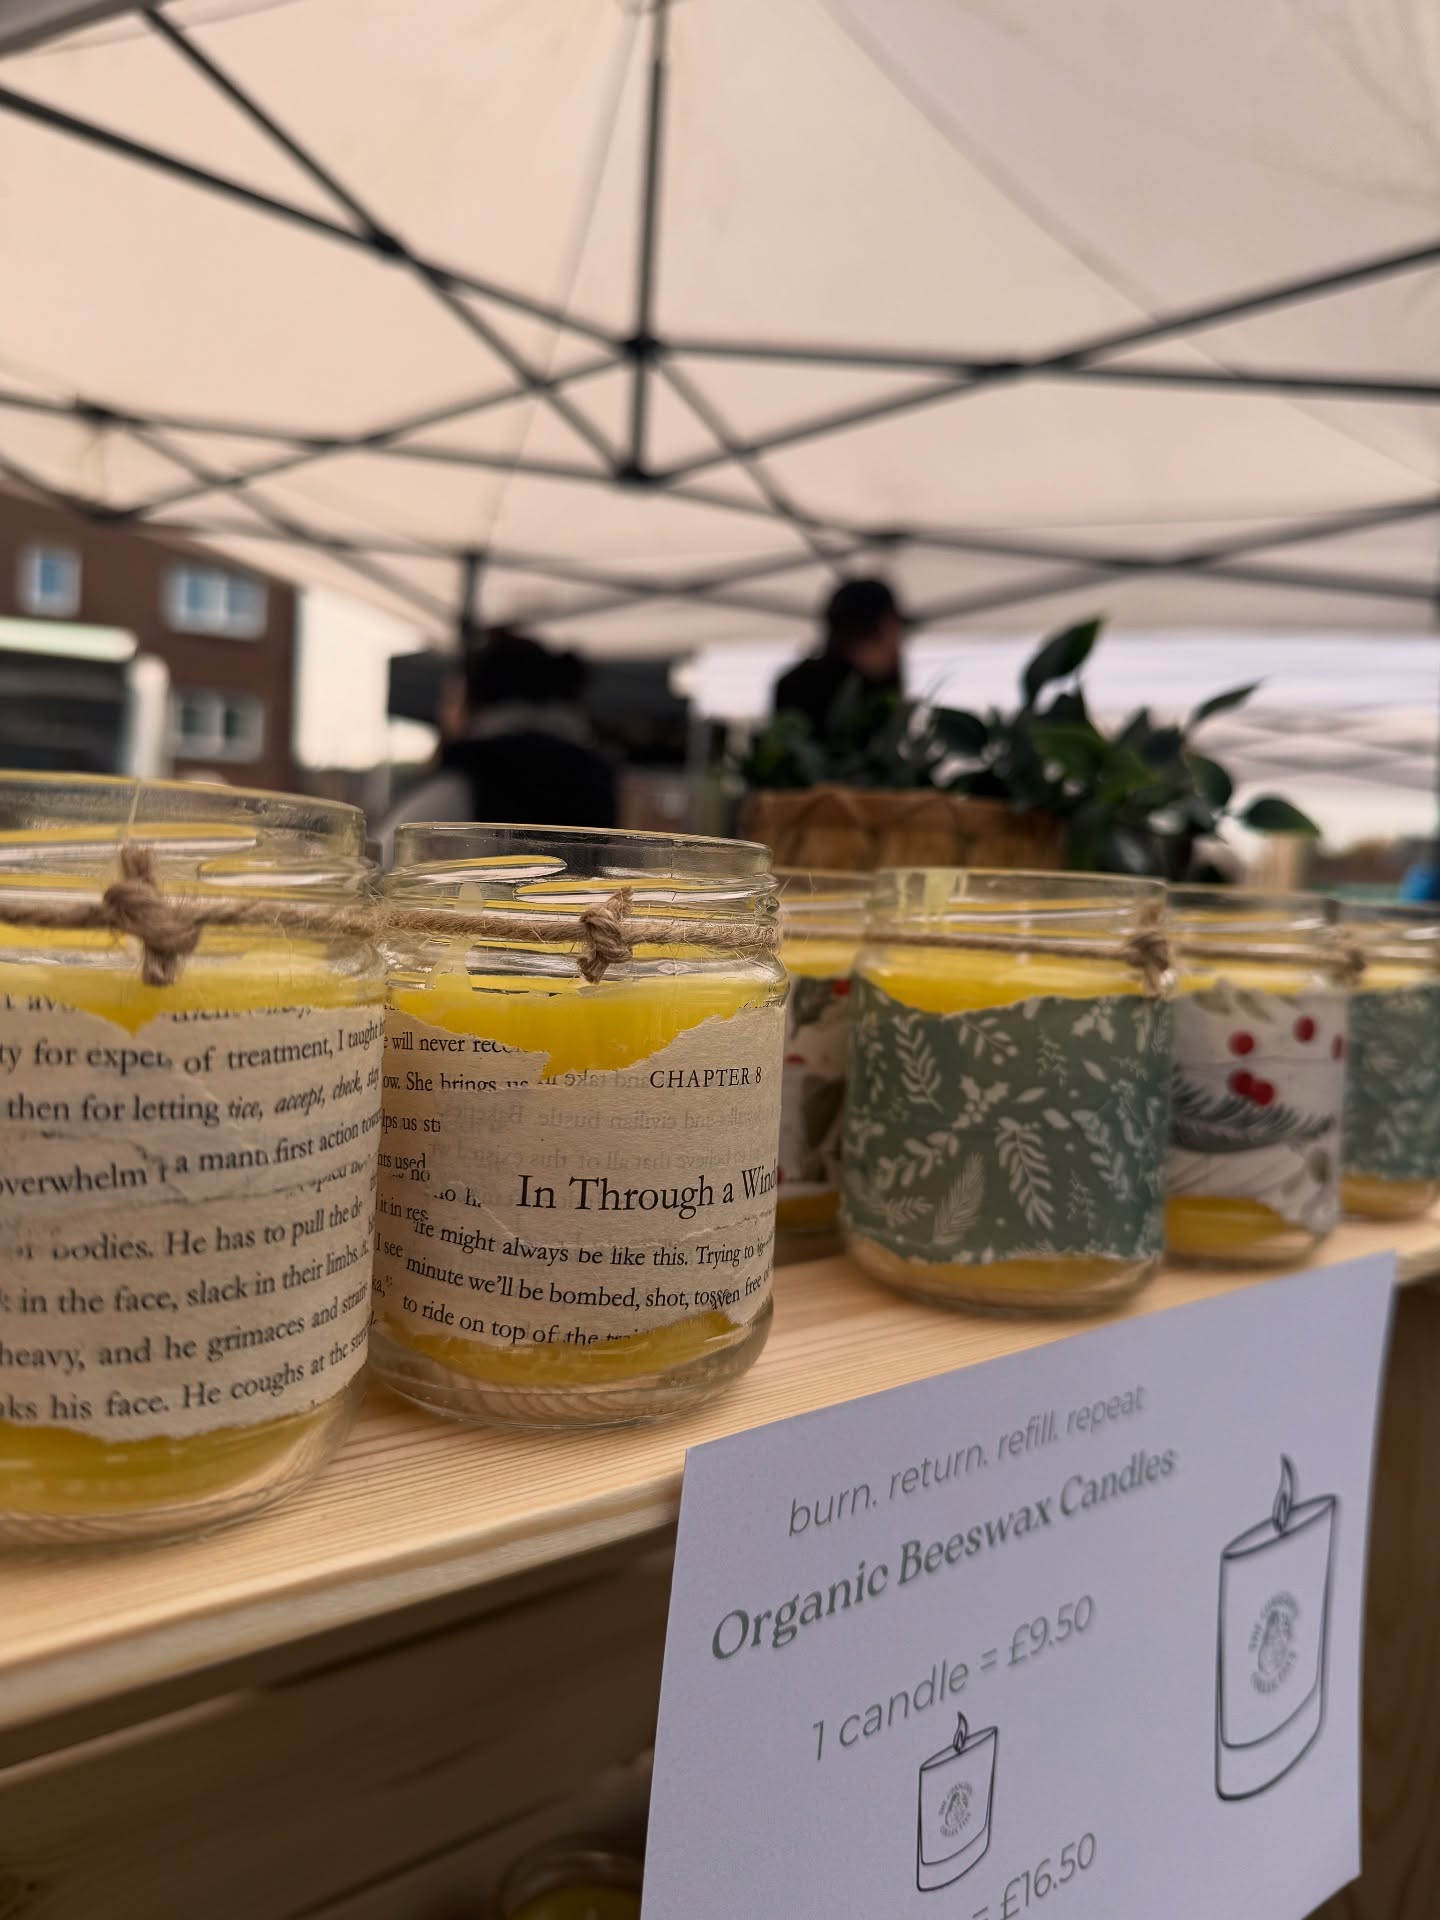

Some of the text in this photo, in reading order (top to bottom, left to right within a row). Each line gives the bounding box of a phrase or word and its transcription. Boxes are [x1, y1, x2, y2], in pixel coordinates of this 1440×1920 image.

[35, 1037, 77, 1066] for
[184, 1047, 216, 1075] of
[228, 1036, 333, 1071] treatment,
[337, 1029, 344, 1051] I
[348, 1019, 378, 1050] taught
[392, 1031, 413, 1050] will
[420, 1038, 465, 1052] never
[8, 1092, 69, 1121] then
[82, 1093, 125, 1121] for
[134, 1093, 221, 1129] letting
[274, 1085, 325, 1117] accept,
[332, 1070, 363, 1102] check,
[406, 1071, 433, 1092] She
[650, 1066, 762, 1089] CHAPTER 8
[319, 1122, 359, 1152] action
[402, 1117, 418, 1131] us
[516, 1174, 557, 1209] In
[569, 1175, 714, 1220] Through
[722, 1181, 735, 1204] a
[166, 1229, 207, 1256] He
[216, 1226, 256, 1252] has
[264, 1224, 286, 1245] to
[292, 1207, 325, 1247] pull
[329, 1203, 349, 1228] the
[384, 1240, 403, 1258] see
[440, 1226, 496, 1254] might
[502, 1237, 569, 1267] always
[578, 1247, 603, 1264] be
[610, 1247, 646, 1266] like
[653, 1247, 689, 1266] this.
[696, 1244, 740, 1269] Trying
[744, 1244, 755, 1260] to
[22, 1287, 48, 1313] in
[58, 1287, 105, 1315] the
[115, 1284, 178, 1313] face,
[186, 1274, 248, 1307] slack
[255, 1271, 276, 1297] in
[282, 1258, 323, 1290] their
[406, 1256, 464, 1287] minute
[468, 1274, 513, 1297] we’ll
[518, 1278, 544, 1301] be
[550, 1282, 640, 1312] bombed,
[645, 1286, 690, 1310] shot,
[745, 1276, 762, 1297] free
[99, 1336, 152, 1366] and
[165, 1334, 197, 1361] he
[207, 1317, 306, 1363] grimaces
[311, 1296, 338, 1329] and
[403, 1295, 418, 1313] to
[422, 1300, 455, 1326] ride
[460, 1316, 485, 1334] on
[492, 1321, 526, 1344] top
[533, 1325, 559, 1344] of
[51, 1393, 93, 1420] his
[106, 1390, 169, 1417] face.
[183, 1378, 221, 1409] He
[230, 1362, 305, 1397] coughs
[311, 1354, 325, 1376] at
[329, 1341, 349, 1366] the
[787, 1386, 1145, 1538] burn. return. refill. repeat
[711, 1446, 1177, 1660] Organic Beeswax Candles
[811, 1720, 825, 1762] 1
[838, 1659, 969, 1749] candle
[1006, 1594, 1096, 1667] £9.50
[1000, 1832, 1097, 1920] £16.50
